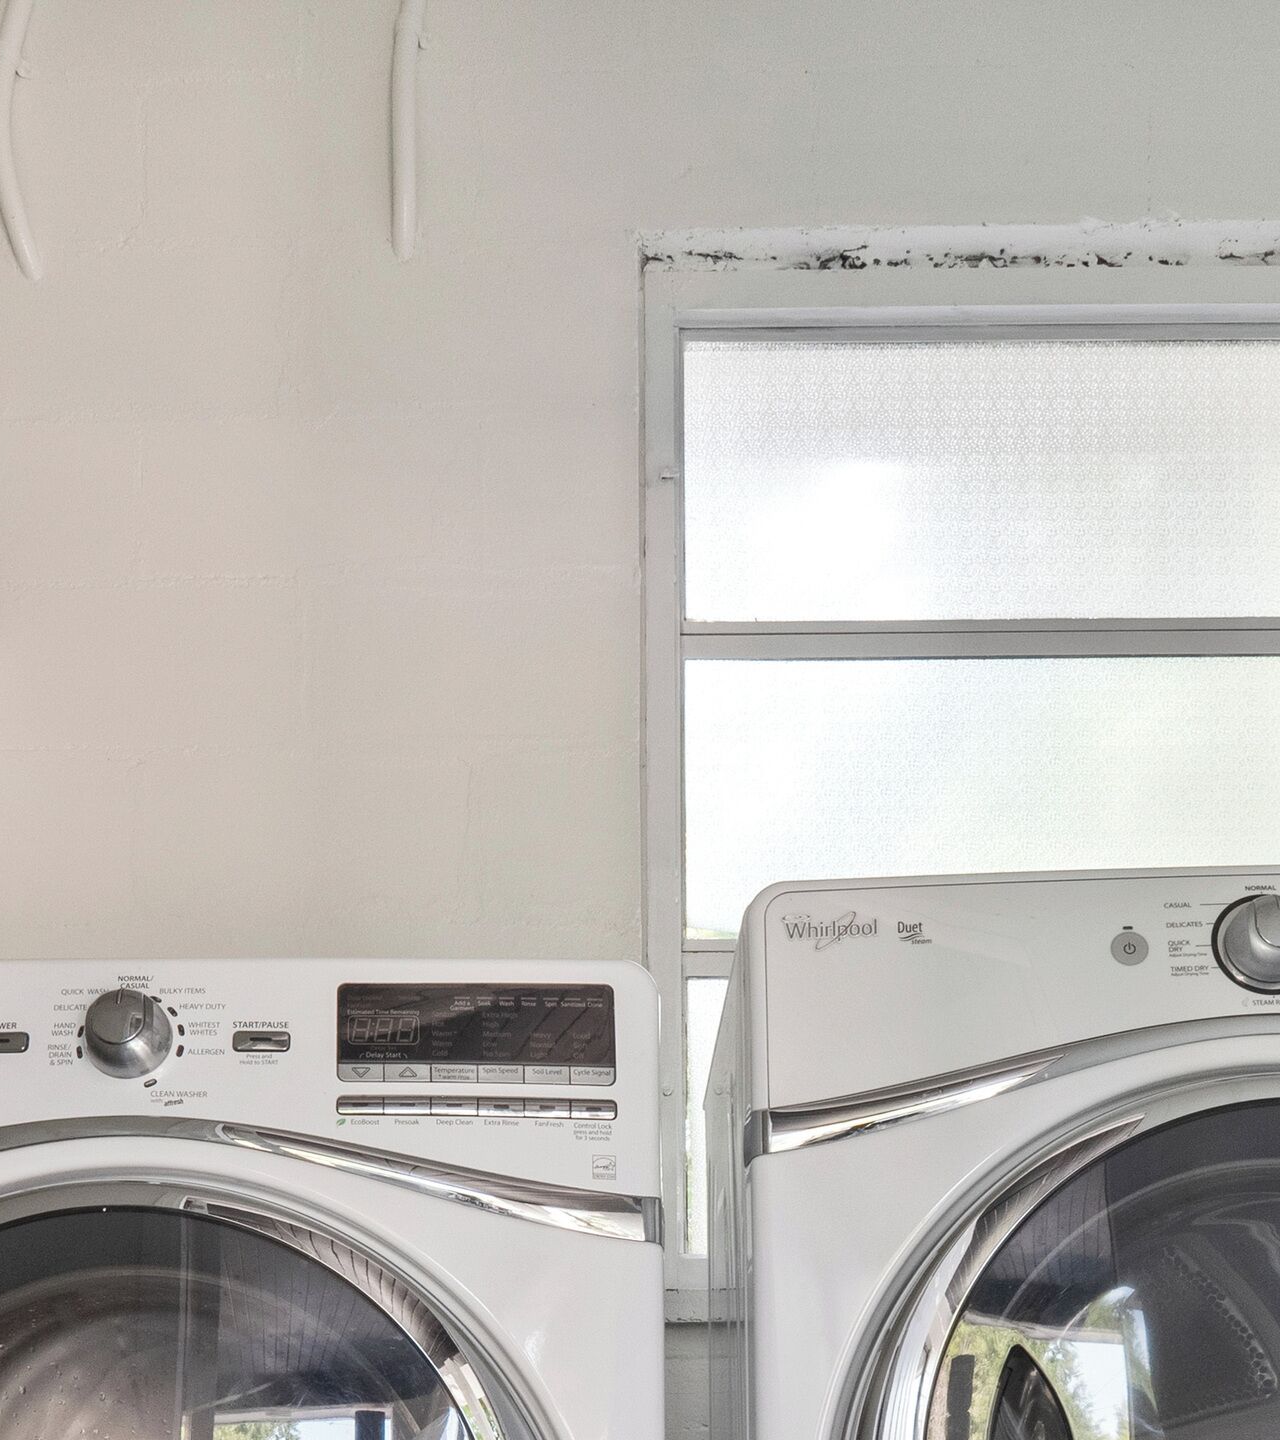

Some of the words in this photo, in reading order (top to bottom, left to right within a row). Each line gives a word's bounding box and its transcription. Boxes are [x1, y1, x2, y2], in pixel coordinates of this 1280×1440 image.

[783, 916, 878, 944] Whirlpool
[897, 921, 923, 934] Duet
[61, 988, 84, 996] QUICK
[232, 1021, 289, 1029] START/PAUSE
